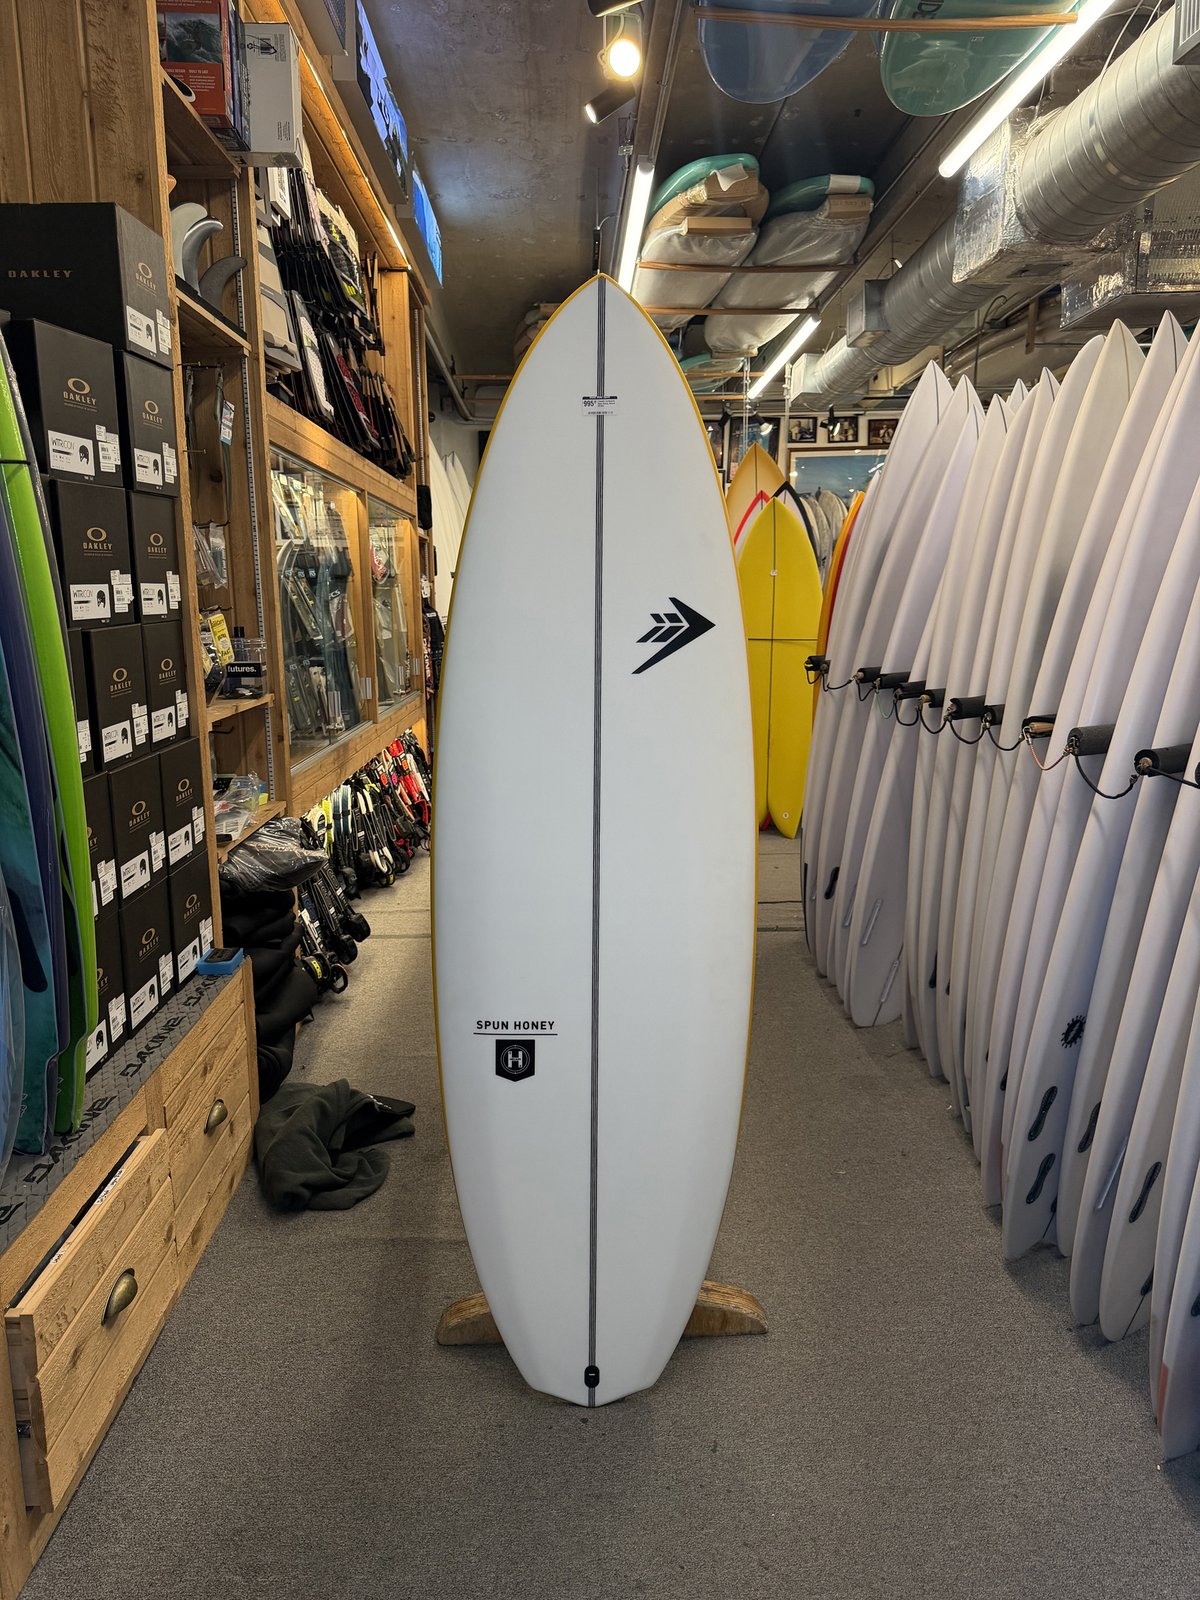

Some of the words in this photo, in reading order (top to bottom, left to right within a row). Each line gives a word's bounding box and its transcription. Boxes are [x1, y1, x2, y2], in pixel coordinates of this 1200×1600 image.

[8, 270, 73, 278] OAKLEY
[135, 272, 157, 291] OAKLEY
[63, 391, 97, 406] OAKLEY
[142, 412, 163, 424] OAKLEY
[82, 542, 113, 550] OAKLEY
[147, 546, 167, 554] OAKLEY
[158, 670, 177, 680] OAKLEY
[227, 665, 257, 673] futures.
[109, 680, 132, 692] OAKLEY
[175, 788, 193, 802] OAKLEY
[128, 810, 151, 827] OAKLEY
[138, 936, 160, 957] OAKLEY
[476, 1020, 509, 1030] SPUN
[513, 1020, 555, 1030] HONEY
[507, 1050, 523, 1069] H
